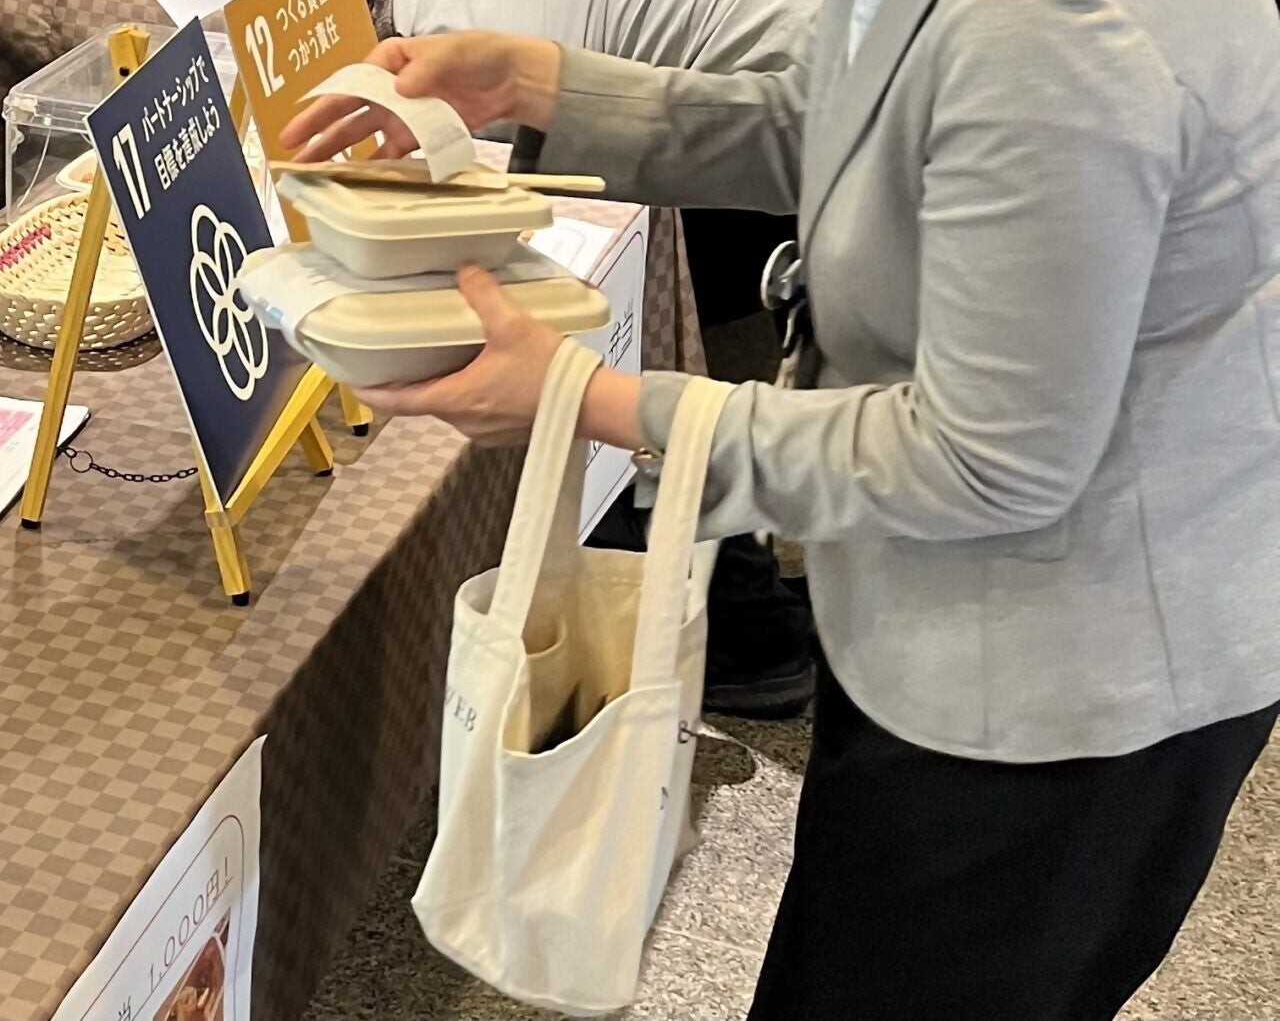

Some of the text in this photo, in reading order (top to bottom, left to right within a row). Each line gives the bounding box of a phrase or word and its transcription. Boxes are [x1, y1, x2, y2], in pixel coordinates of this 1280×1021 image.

[245, 15, 286, 98] 12
[288, 14, 341, 72] つかう責任
[141, 54, 210, 143] パートナーシップで
[112, 123, 152, 220] 17
[154, 97, 220, 191] 目標を達成しよう
